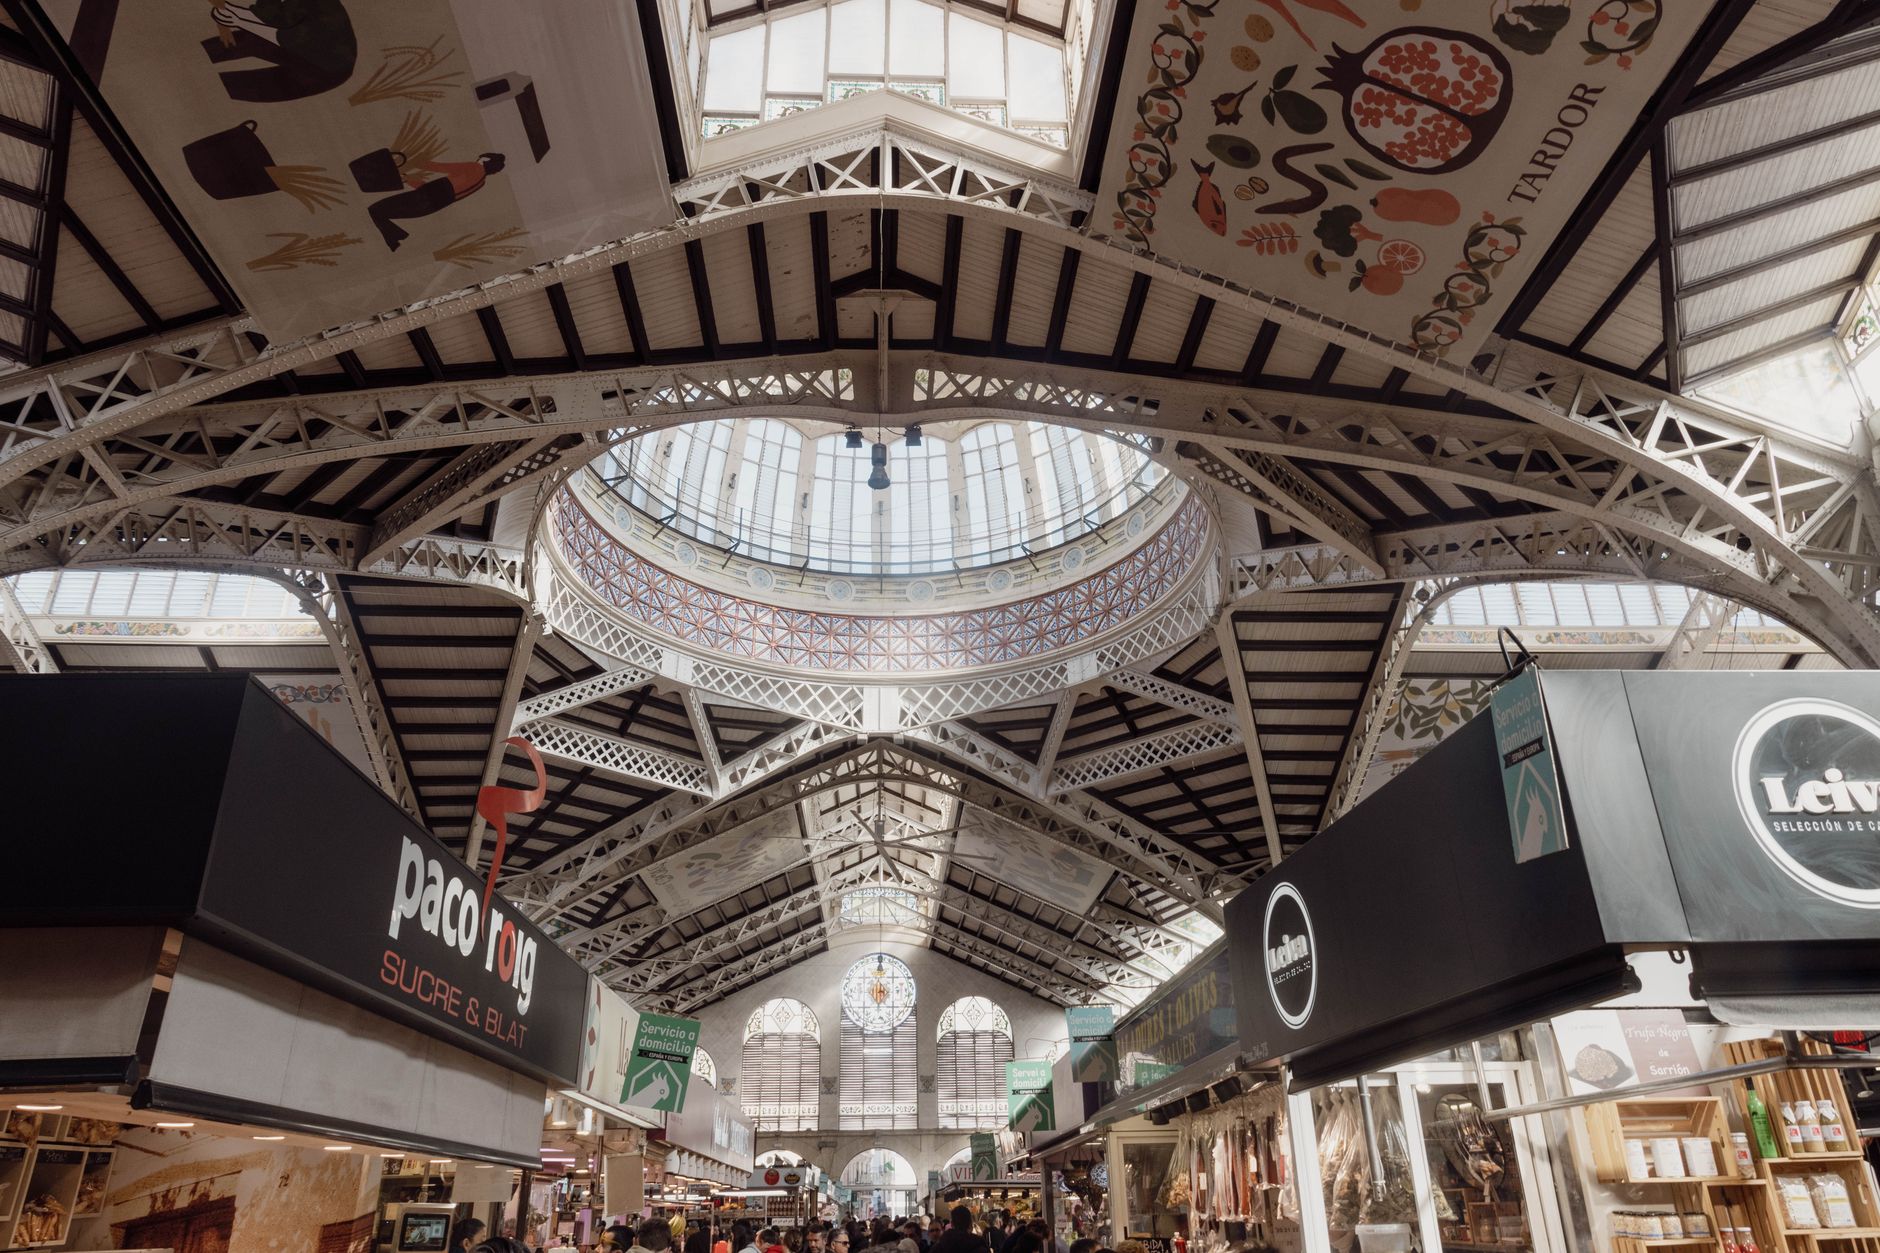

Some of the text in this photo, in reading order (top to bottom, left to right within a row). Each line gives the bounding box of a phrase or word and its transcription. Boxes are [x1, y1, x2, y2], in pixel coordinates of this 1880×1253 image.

[1507, 83, 1607, 203] TARDOR
[1495, 692, 1539, 728] Servicio a
[1501, 716, 1543, 753] domicilio
[1759, 767, 1880, 815] Leiv
[1773, 819, 1843, 832] SELECCIÓN
[1846, 820, 1864, 832] DE
[388, 835, 538, 1015] paco roig
[1267, 934, 1309, 973] Leiva
[380, 950, 527, 1048] SUCRE & BLAT
[1175, 971, 1217, 1030] OLIVES
[1070, 1014, 1104, 1025] Servicio
[641, 1020, 695, 1041] Servicio a
[1624, 1025, 1655, 1042] Trufa
[1656, 1023, 1688, 1042] Negra
[639, 1035, 691, 1054] domicilio
[1658, 1048, 1669, 1057] de
[1012, 1067, 1039, 1077] Servei
[1650, 1063, 1690, 1076] Sarrión
[1012, 1078, 1047, 1088] domicili
